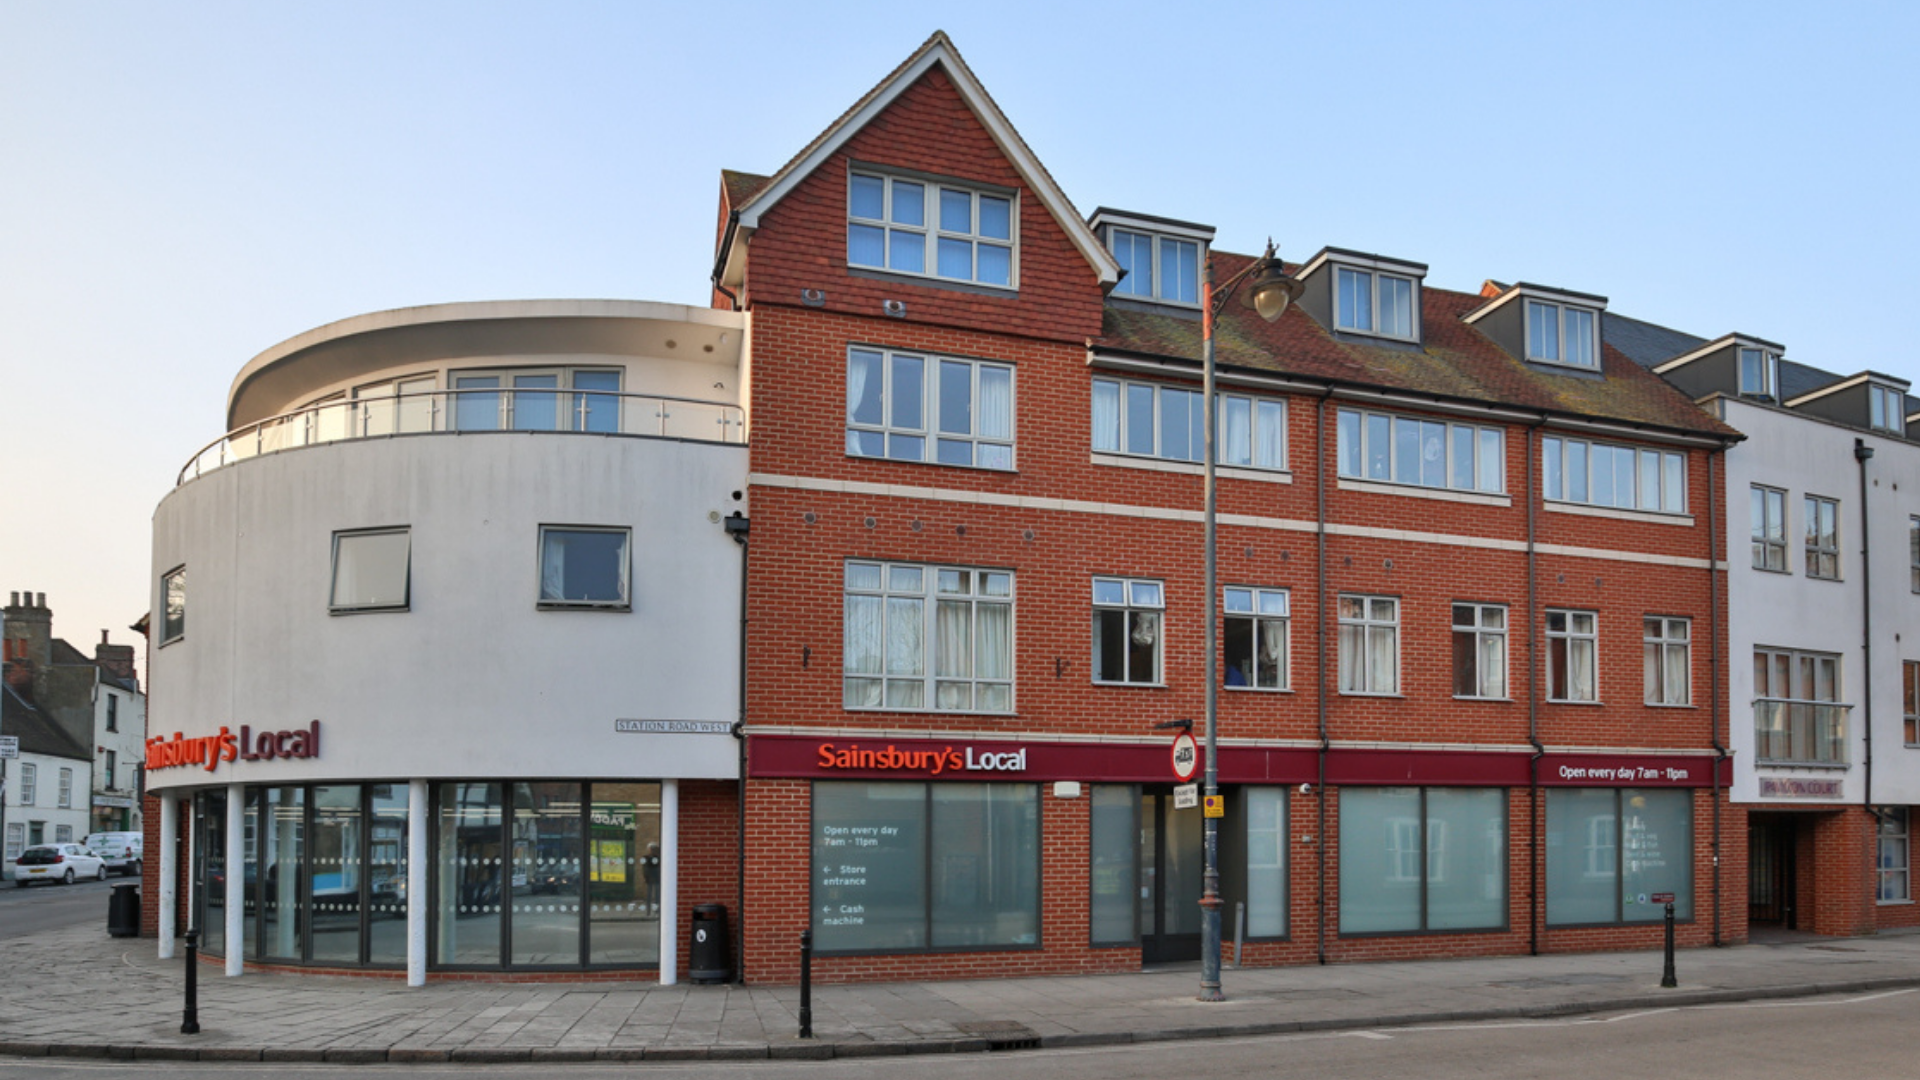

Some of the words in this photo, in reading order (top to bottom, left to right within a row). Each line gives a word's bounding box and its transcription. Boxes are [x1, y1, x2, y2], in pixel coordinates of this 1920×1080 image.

[619, 721, 665, 731] STATION
[668, 721, 698, 731] ROAD
[701, 722, 728, 732] WEST
[240, 720, 320, 760] Local
[818, 743, 963, 774] Sainsbury's
[965, 747, 1027, 771] Local
[1559, 765, 1586, 780] Open
[1587, 768, 1615, 780] every
[1617, 766, 1635, 780] day
[1636, 767, 1658, 779] 7am
[823, 826, 849, 836] Open
[851, 826, 879, 836] every
[880, 826, 899, 836] day
[823, 837, 846, 846] 7am
[855, 837, 879, 847] 11pm
[840, 865, 867, 874] Store
[823, 877, 867, 886] entrance
[840, 904, 865, 914] Cash
[823, 915, 865, 926] machine
